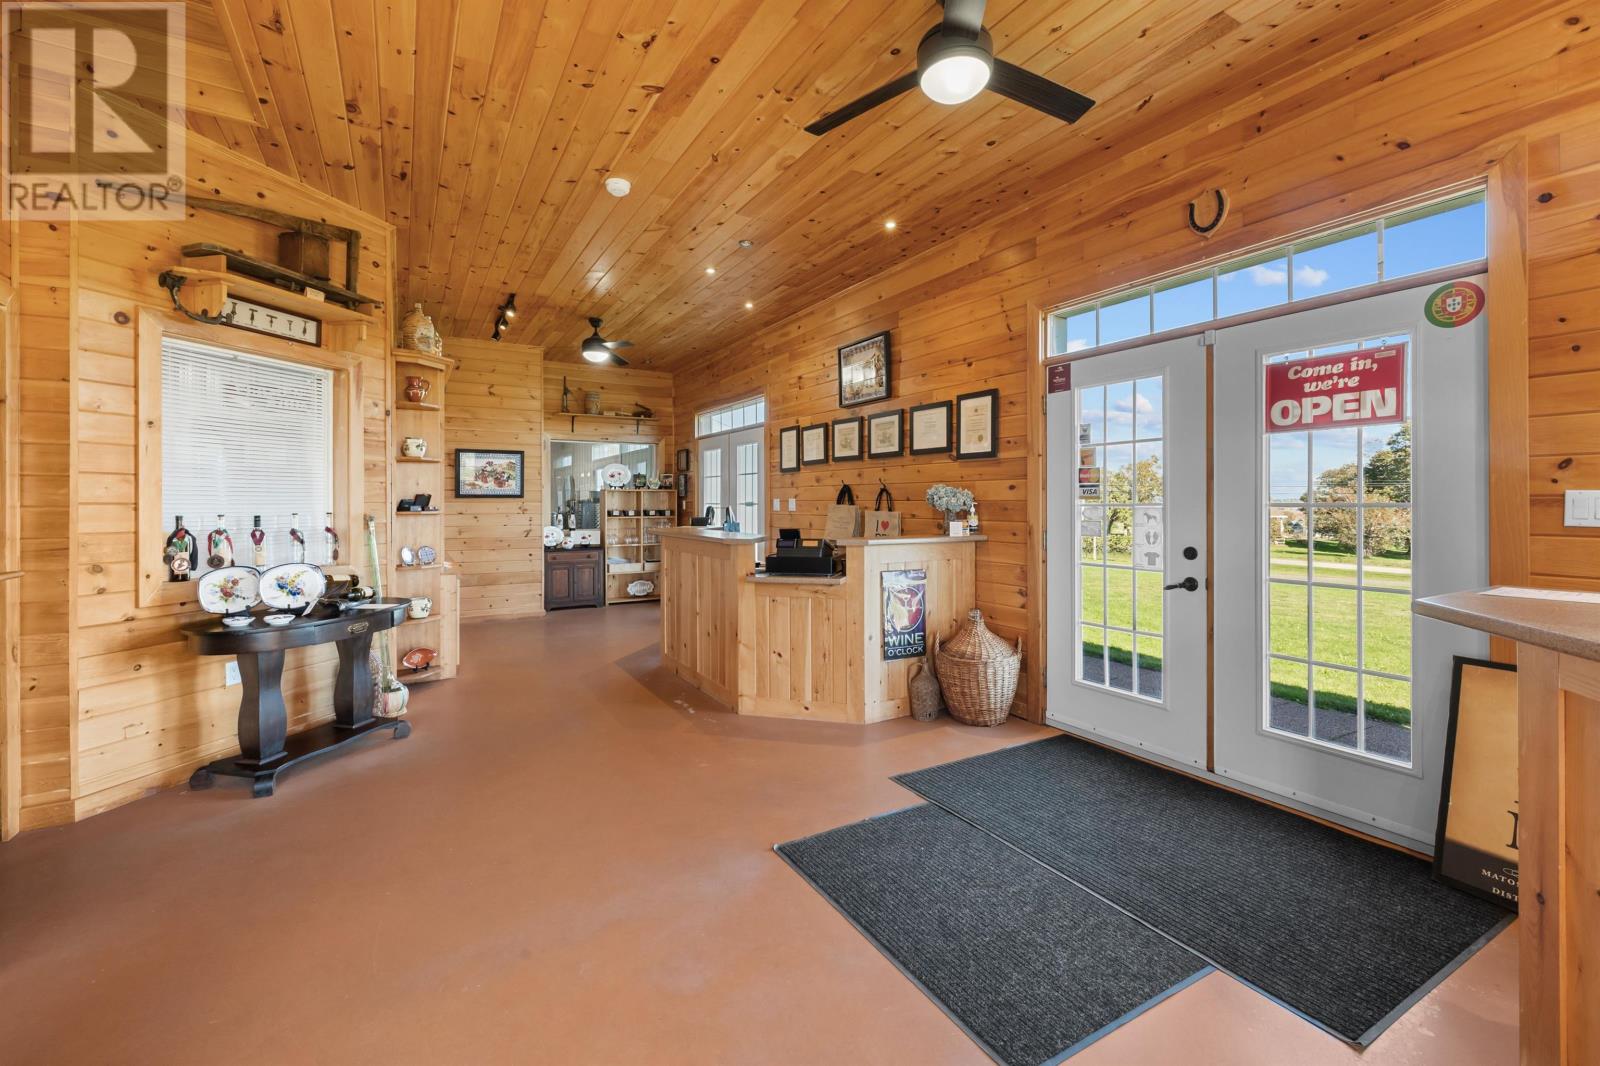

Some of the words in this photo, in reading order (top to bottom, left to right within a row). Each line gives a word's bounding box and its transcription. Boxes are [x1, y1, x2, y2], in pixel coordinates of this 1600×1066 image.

[1287, 362, 1344, 380] Come
[1350, 356, 1378, 371] in,
[1303, 375, 1360, 393] we're
[1270, 387, 1397, 426] OPEN
[887, 632, 924, 647] WINE
[887, 646, 924, 657] O'CLOCK
